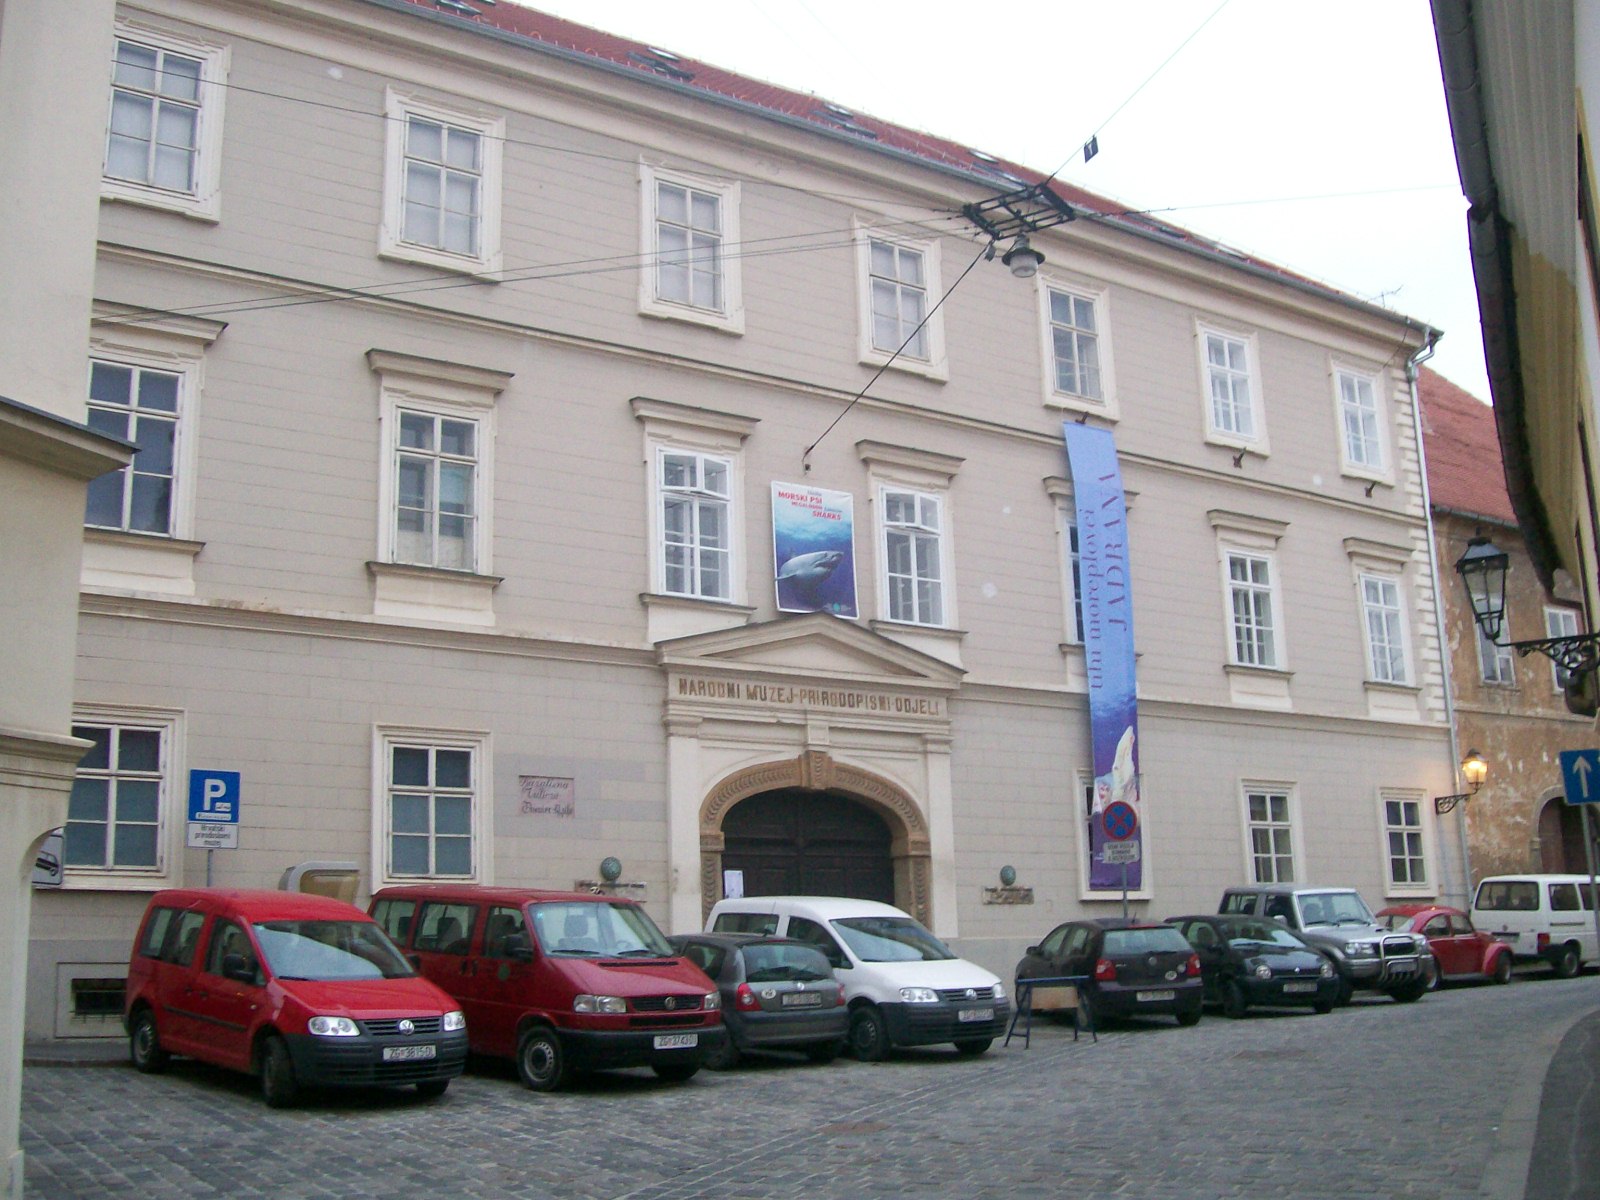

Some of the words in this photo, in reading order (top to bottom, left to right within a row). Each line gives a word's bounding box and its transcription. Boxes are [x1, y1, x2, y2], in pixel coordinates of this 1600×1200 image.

[778, 490, 808, 502] MORSKI
[810, 496, 823, 505] PSI
[812, 510, 841, 521] SHARKS
[678, 677, 740, 700] NARODNI
[895, 695, 940, 716] ODJELI
[204, 779, 226, 810] P
